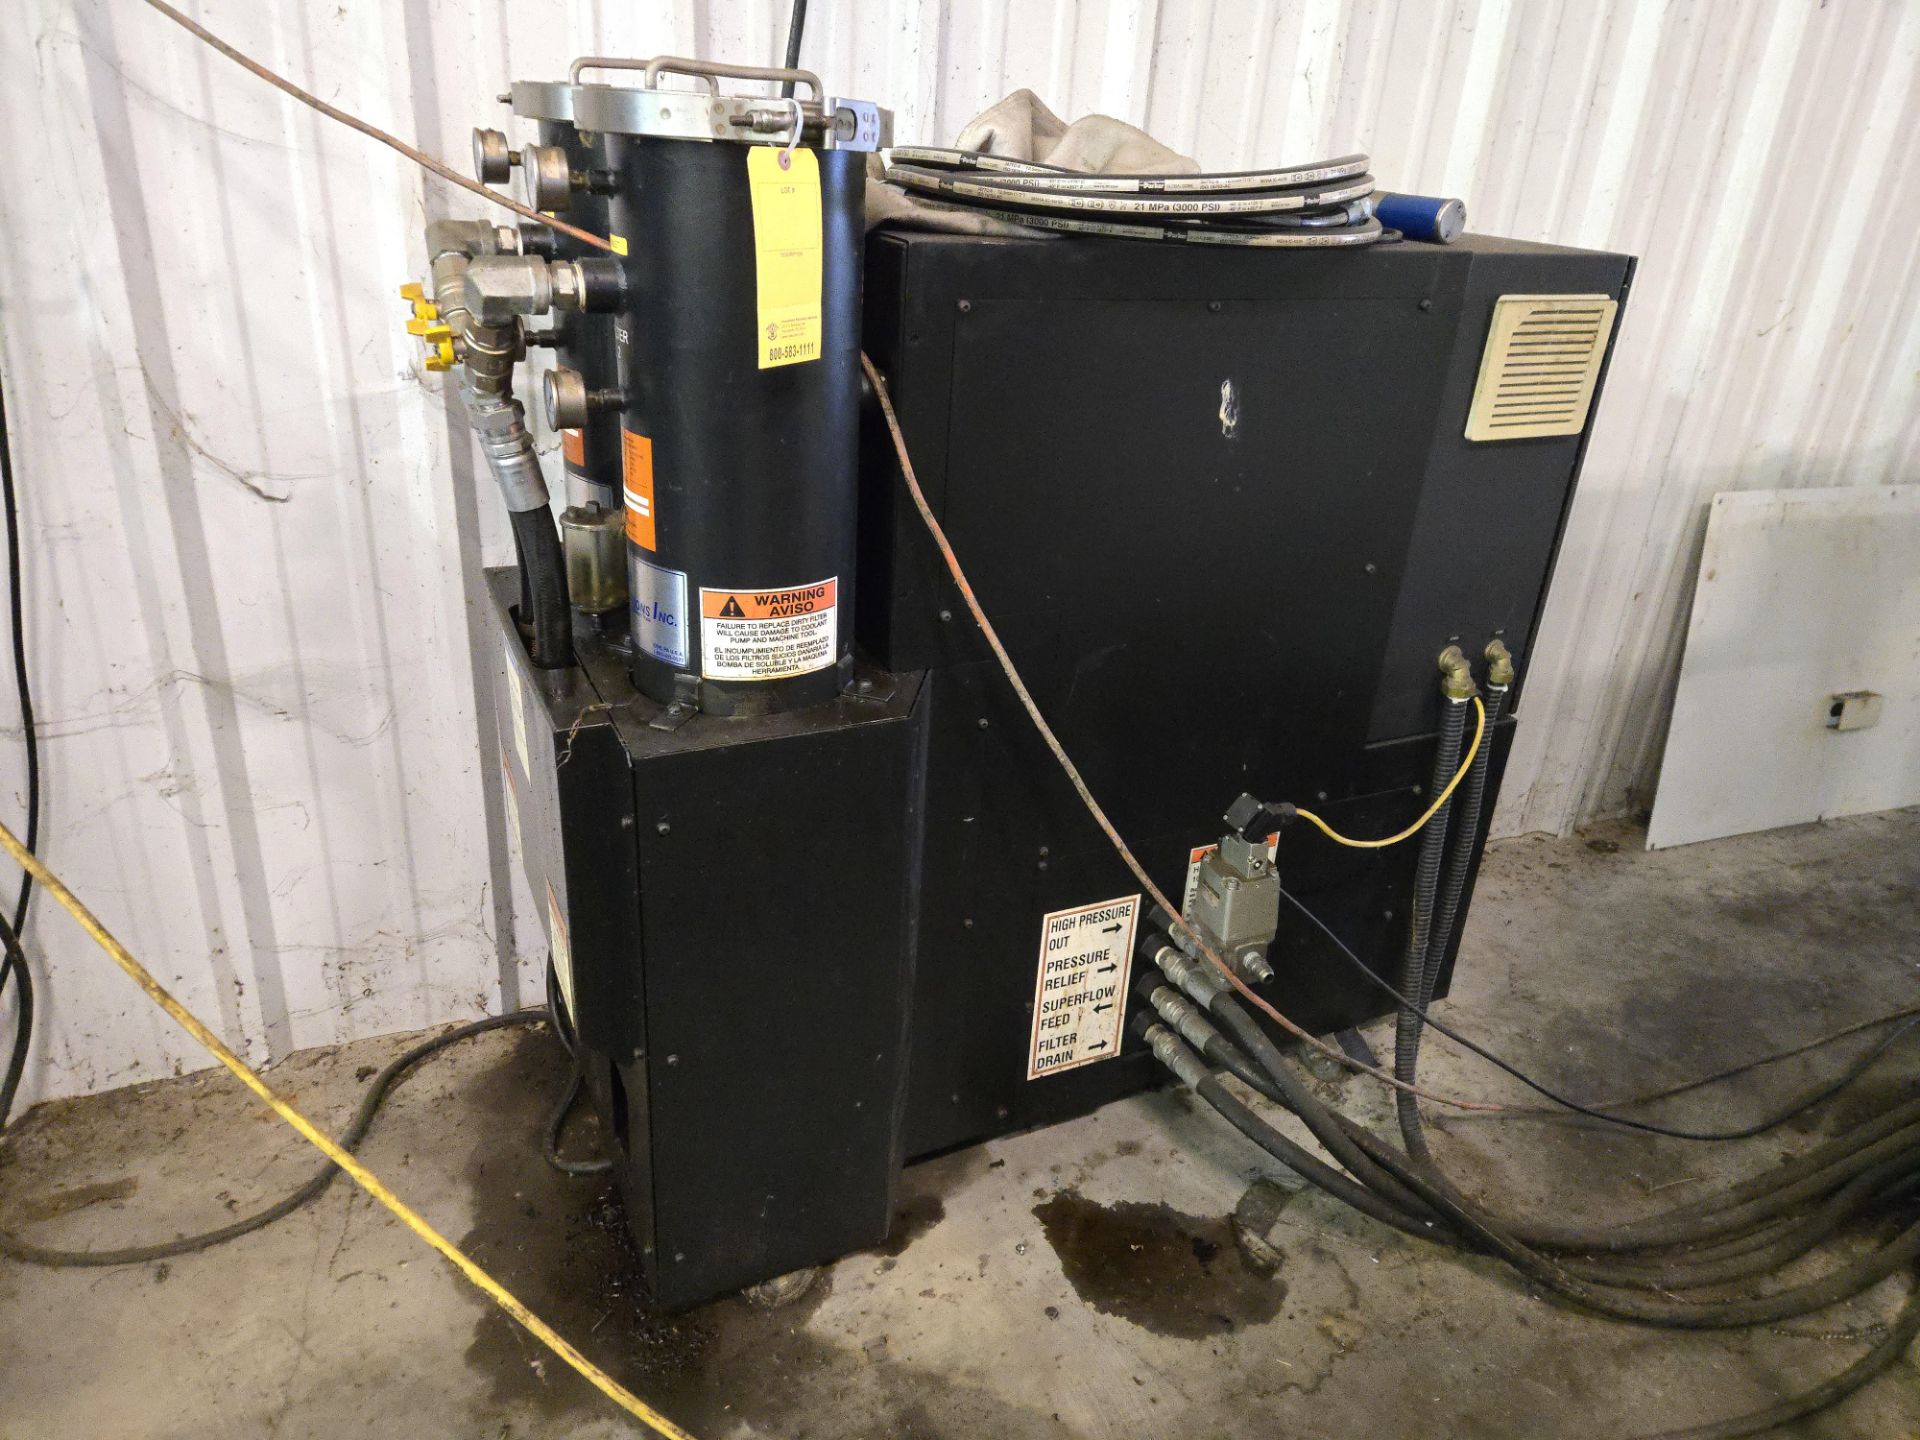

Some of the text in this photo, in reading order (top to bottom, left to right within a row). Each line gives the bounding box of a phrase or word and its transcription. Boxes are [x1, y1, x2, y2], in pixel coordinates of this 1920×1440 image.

[1134, 203, 1145, 211] 21
[1148, 203, 1169, 211] MPa
[1173, 203, 1198, 212] (3000
[1202, 203, 1220, 212] PSI)
[1007, 214, 1024, 223] MPa
[1026, 217, 1049, 227] (3000
[769, 342, 813, 360] 800-583-1111
[755, 587, 825, 606] WARNING
[769, 601, 814, 617] AVISO
[759, 621, 790, 629] REPLACE
[791, 618, 808, 626] DIRTY
[809, 613, 827, 622] FILTER
[801, 619, 827, 631] COOLANT
[725, 646, 784, 654] INCUMPLIMIENTO
[796, 636, 829, 648] REEMPLAZO
[769, 634, 799, 642] MACHINE
[772, 651, 796, 659] SUCIOS
[1050, 905, 1131, 933] HIGH PRESSURE
[1049, 935, 1070, 951] OUT
[1046, 949, 1110, 974] PRESSURE
[1044, 972, 1086, 991] RELIEF
[1042, 985, 1116, 1013] SUPERFLOW
[1040, 1014, 1070, 1030] FEED
[1038, 1033, 1078, 1052] FILTER
[1037, 1050, 1073, 1069] DRAIN
